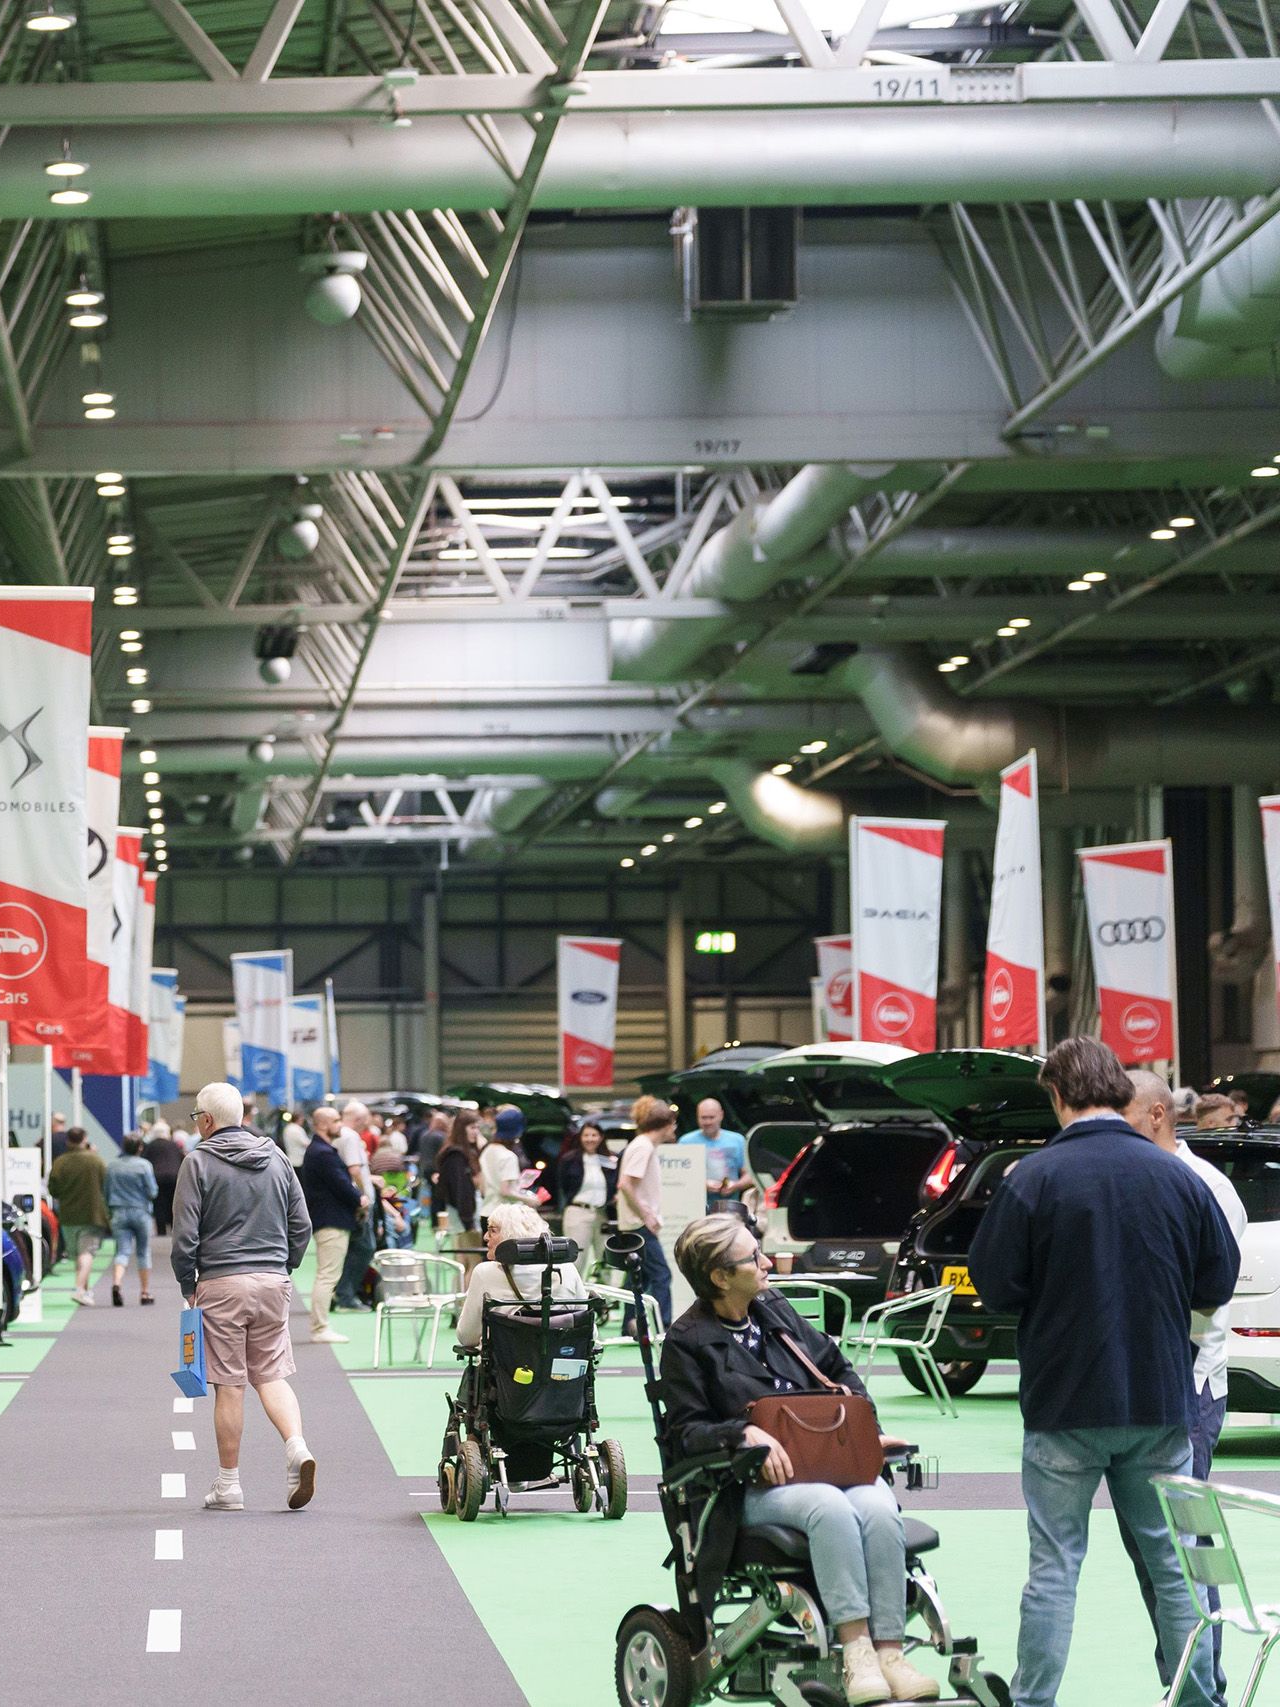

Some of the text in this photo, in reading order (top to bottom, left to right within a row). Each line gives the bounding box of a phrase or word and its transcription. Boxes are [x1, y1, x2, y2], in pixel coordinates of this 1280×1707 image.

[873, 78, 939, 98] 19/11
[695, 439, 742, 455] 19/17
[863, 908, 931, 921] DACIA
[35, 1022, 65, 1036] Cars
[9, 1109, 42, 1129] Hu
[949, 1272, 975, 1288] BX2
